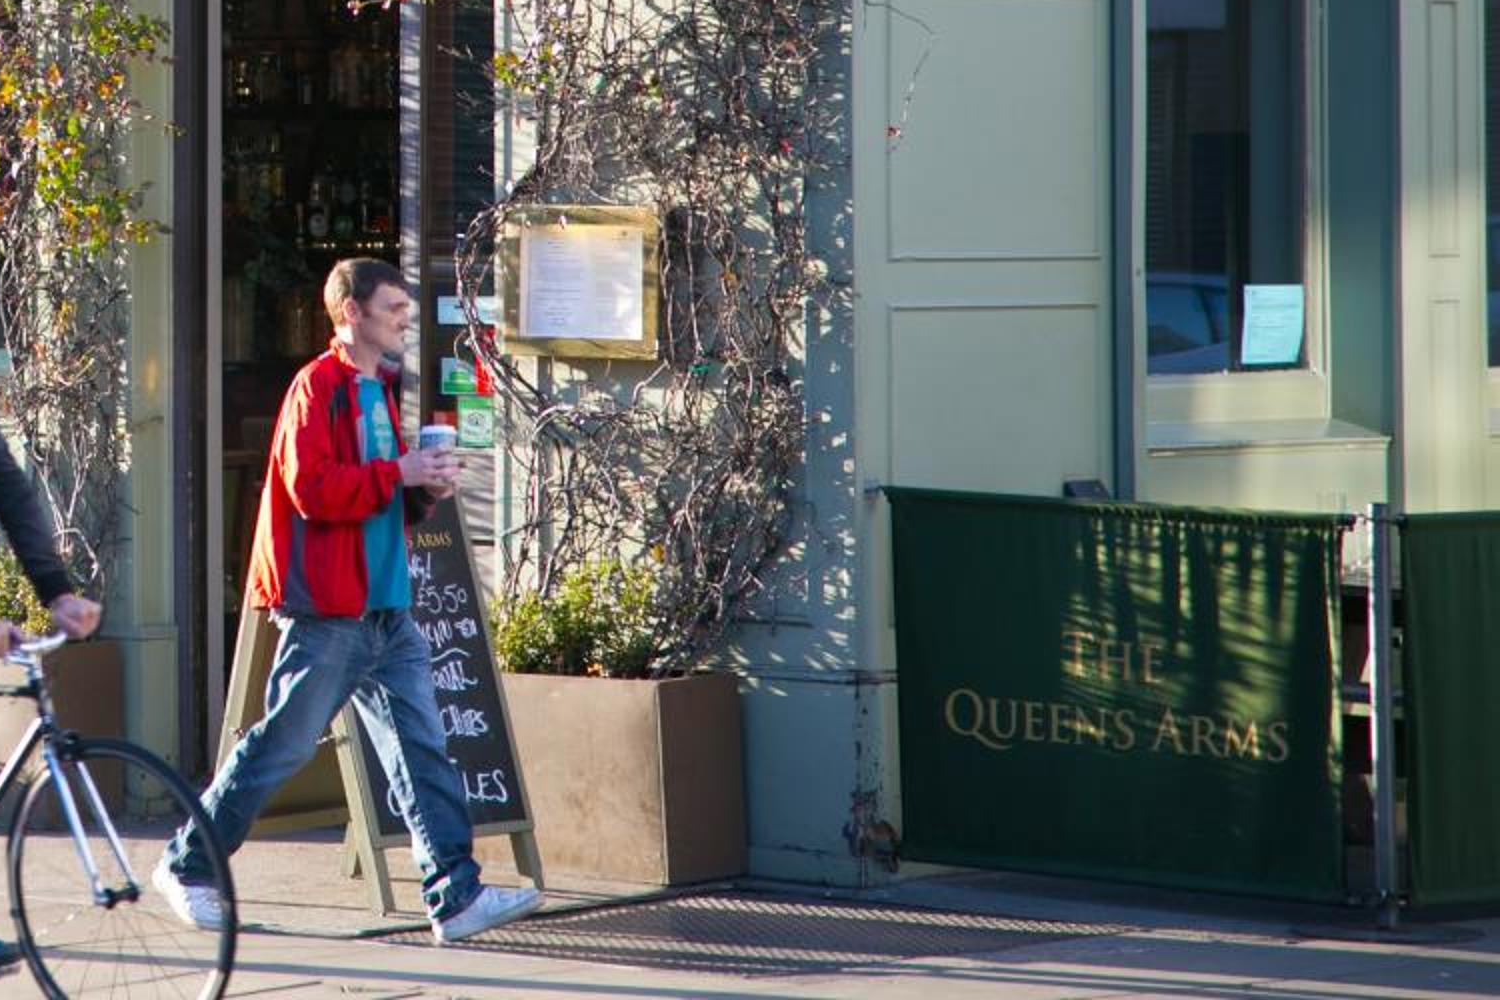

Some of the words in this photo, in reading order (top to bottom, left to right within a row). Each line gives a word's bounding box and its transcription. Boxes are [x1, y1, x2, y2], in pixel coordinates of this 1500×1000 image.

[416, 530, 453, 549] ARMS
[1060, 631, 1167, 685] THE
[945, 688, 1136, 750] QUEENS
[1152, 706, 1289, 762] ARMS
